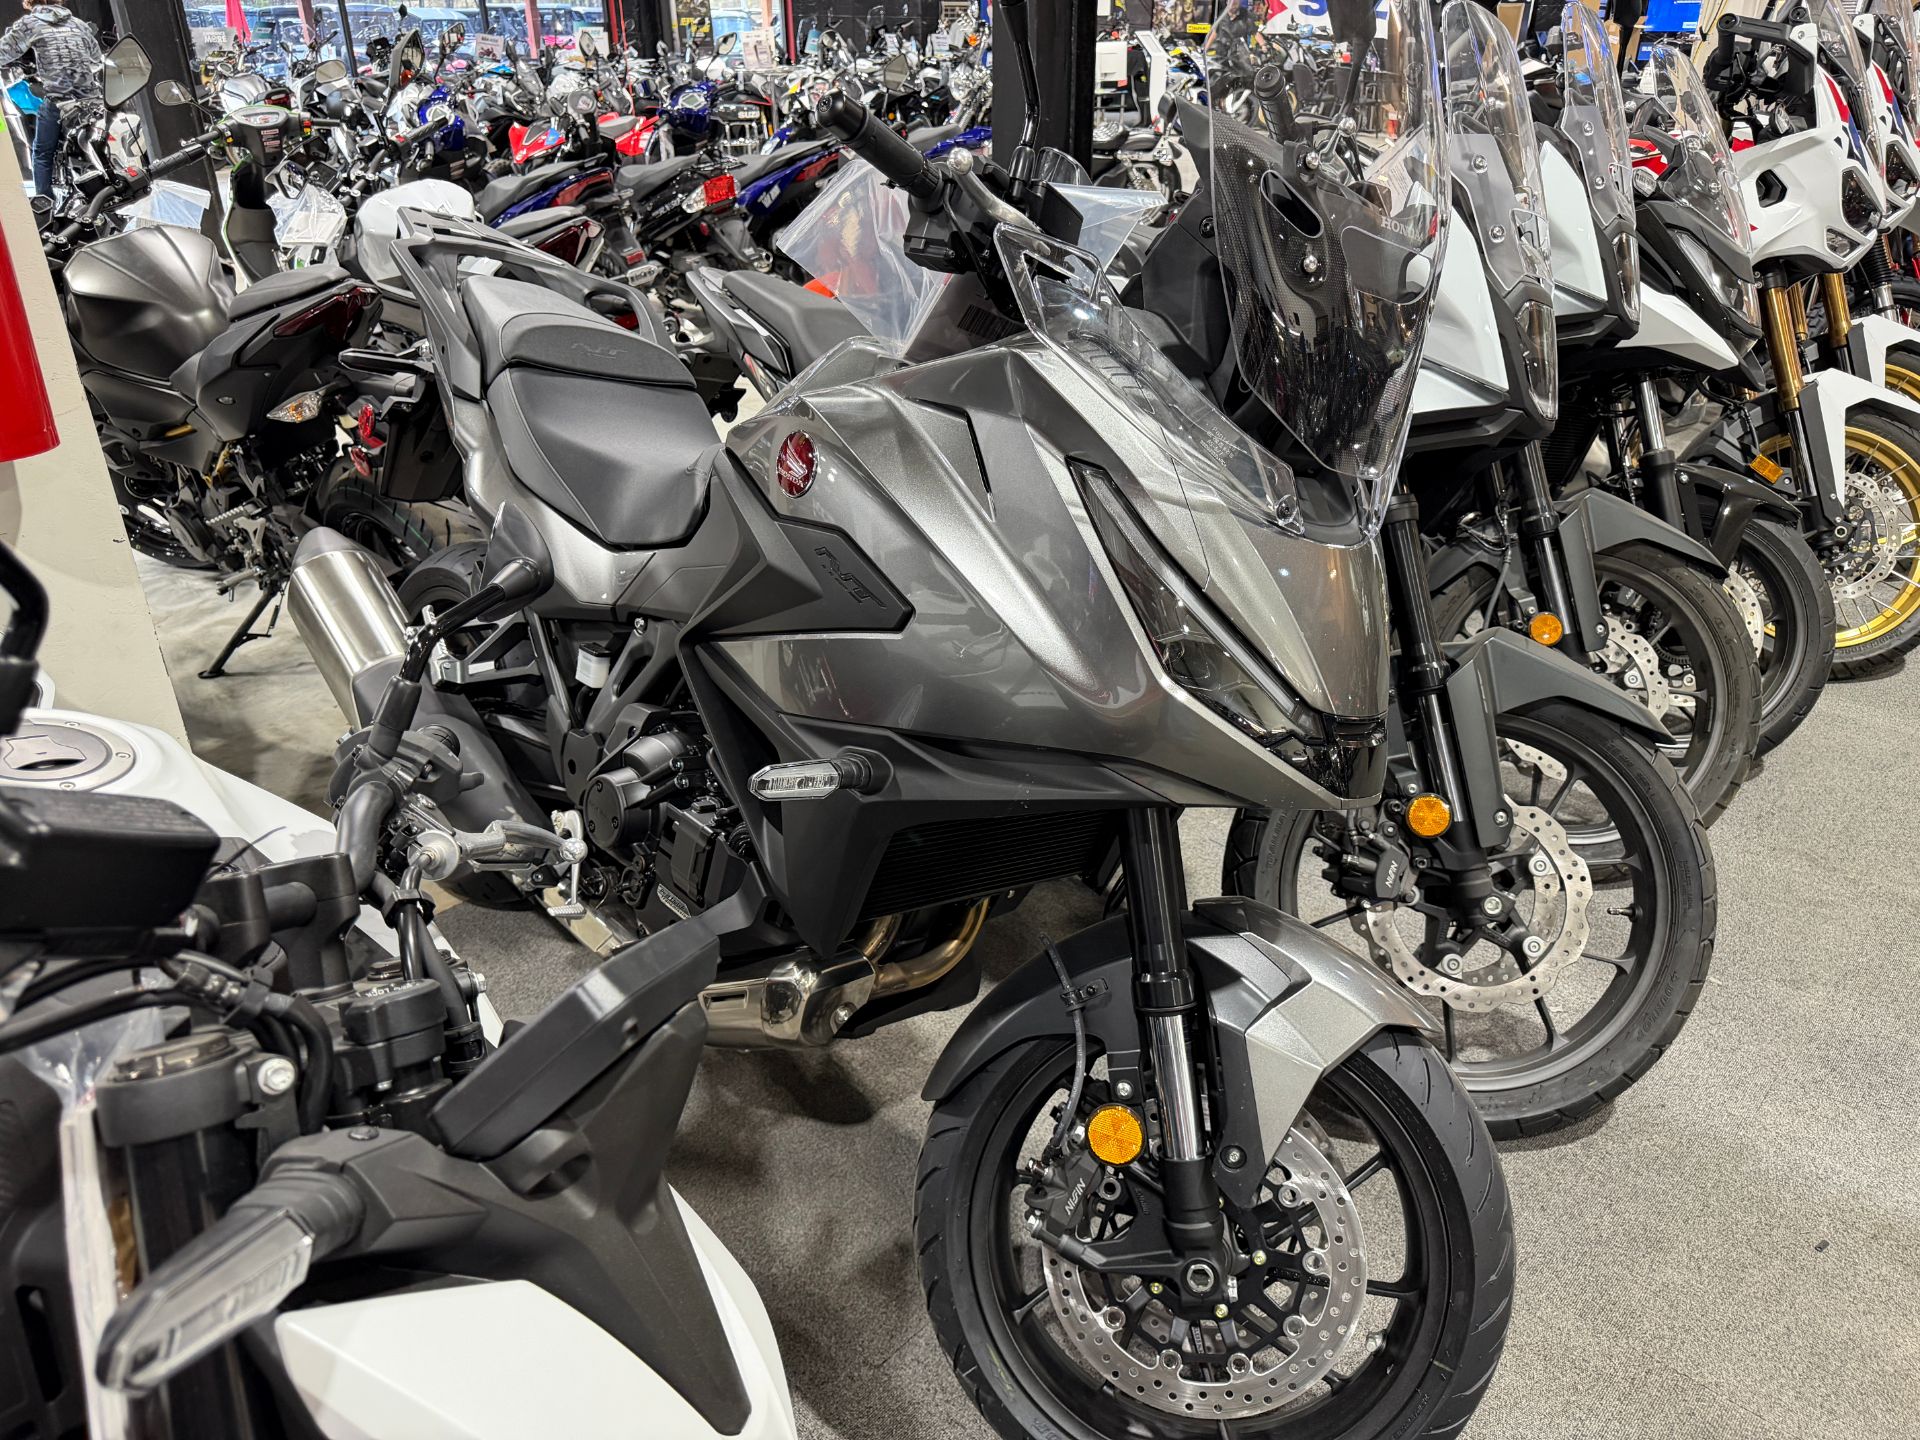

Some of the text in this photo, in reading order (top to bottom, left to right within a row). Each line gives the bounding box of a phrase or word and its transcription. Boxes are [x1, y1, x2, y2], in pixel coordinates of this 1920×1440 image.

[1380, 215, 1424, 242] HONDA
[777, 463, 804, 488] HONDA
[1064, 1177, 1086, 1216] NISSIN
